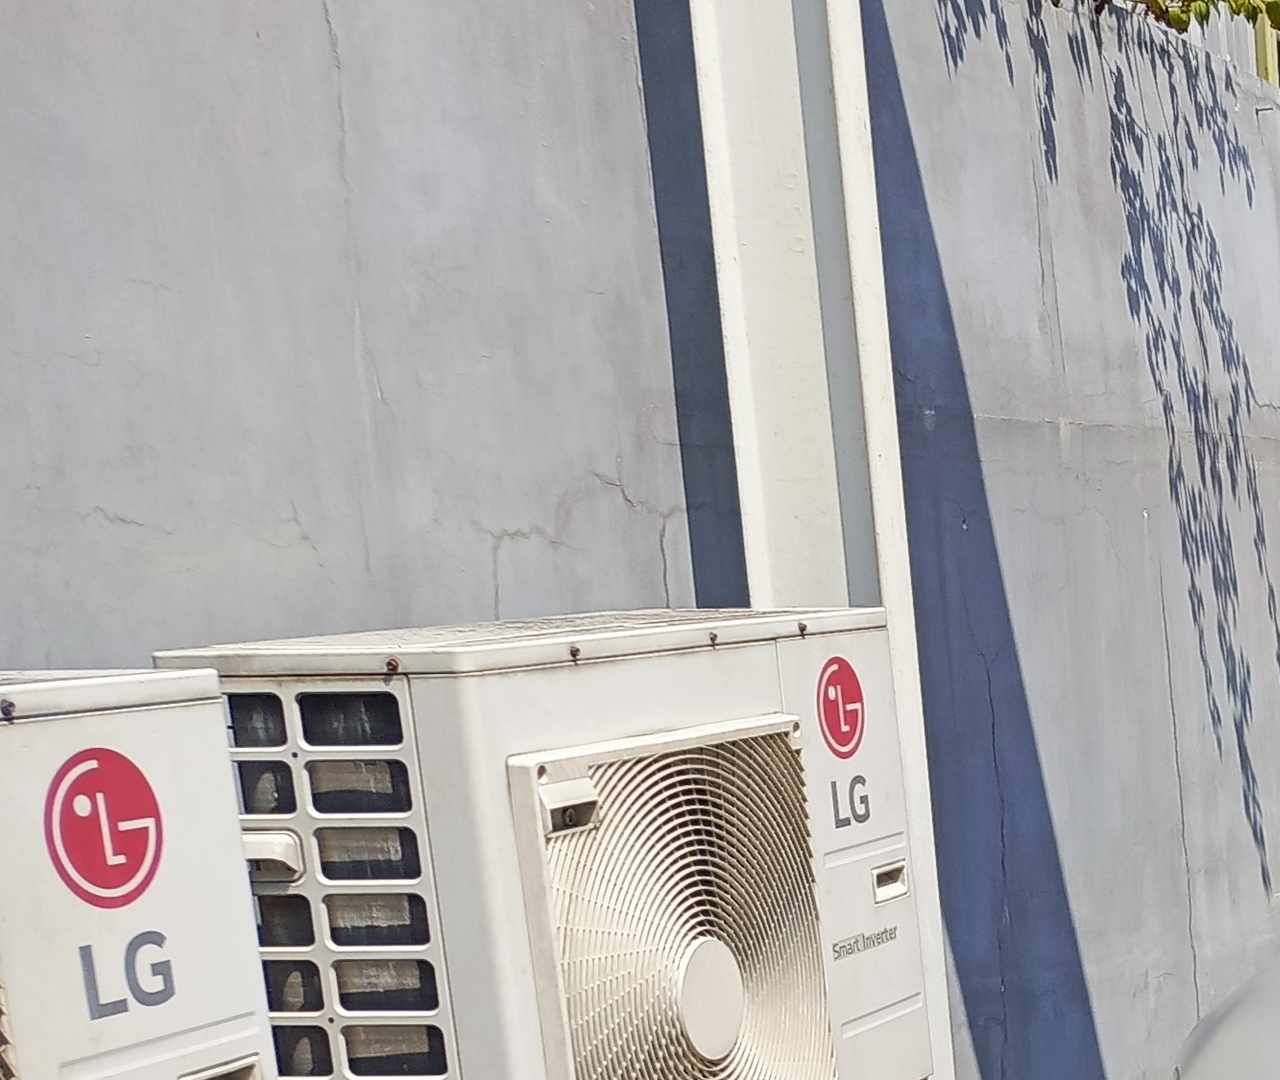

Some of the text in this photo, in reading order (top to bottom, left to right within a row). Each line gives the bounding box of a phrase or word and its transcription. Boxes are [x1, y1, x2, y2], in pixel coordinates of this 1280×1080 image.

[831, 774, 871, 829] LG
[832, 925, 898, 961] Smart Inverter
[78, 930, 177, 1021] LG
